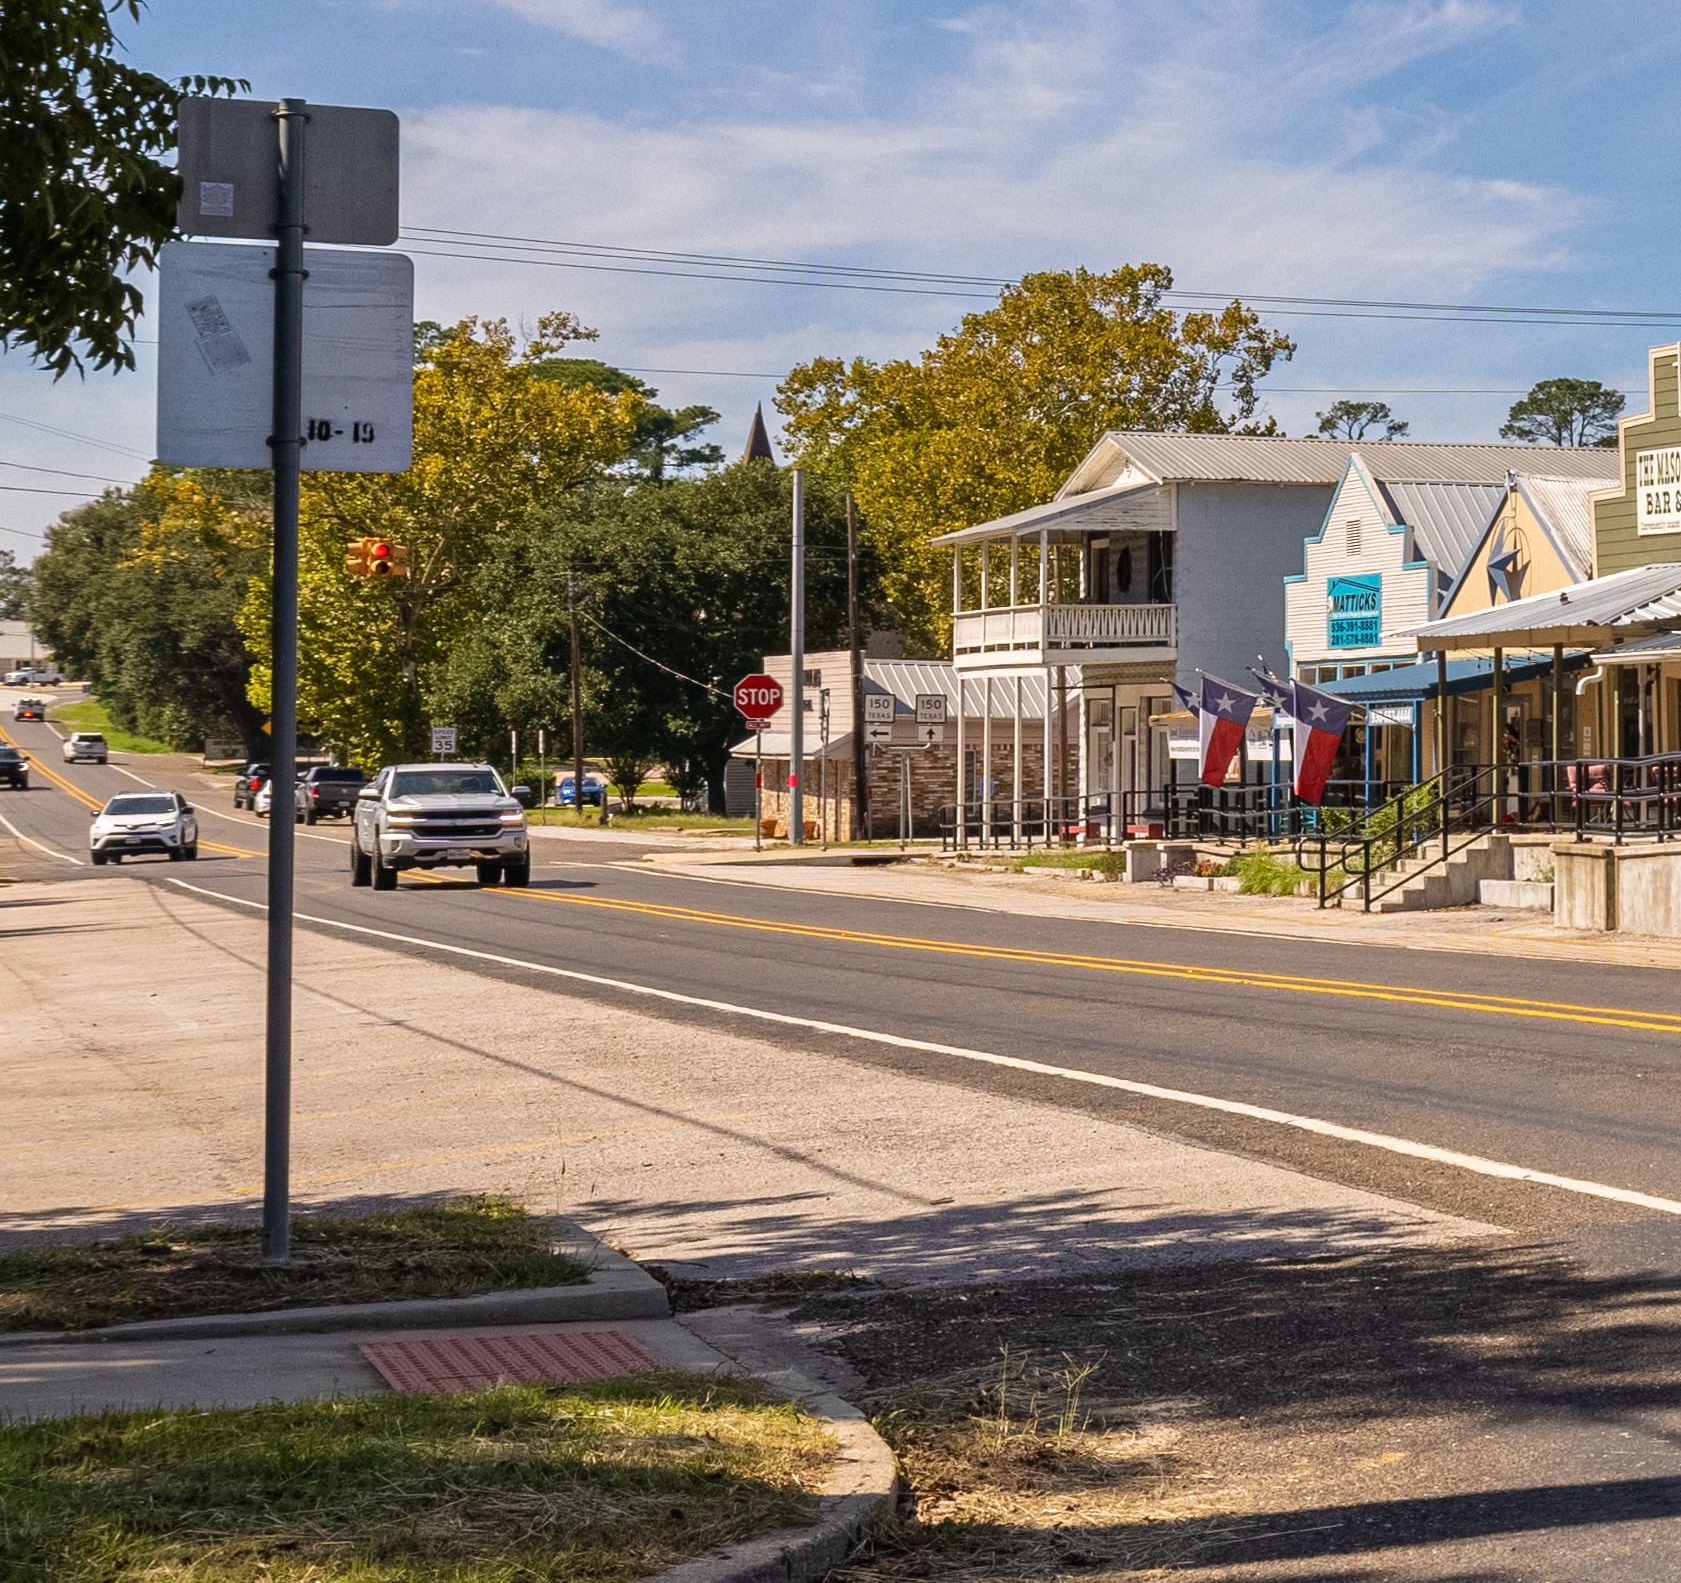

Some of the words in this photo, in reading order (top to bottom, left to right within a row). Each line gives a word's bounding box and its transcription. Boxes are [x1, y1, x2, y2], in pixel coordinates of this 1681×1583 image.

[1639, 454, 1654, 487] THE
[1646, 492, 1671, 515] BAR
[738, 688, 780, 705] STOP
[869, 699, 890, 709] 150
[921, 699, 942, 710] 150
[434, 740, 453, 751] 35
